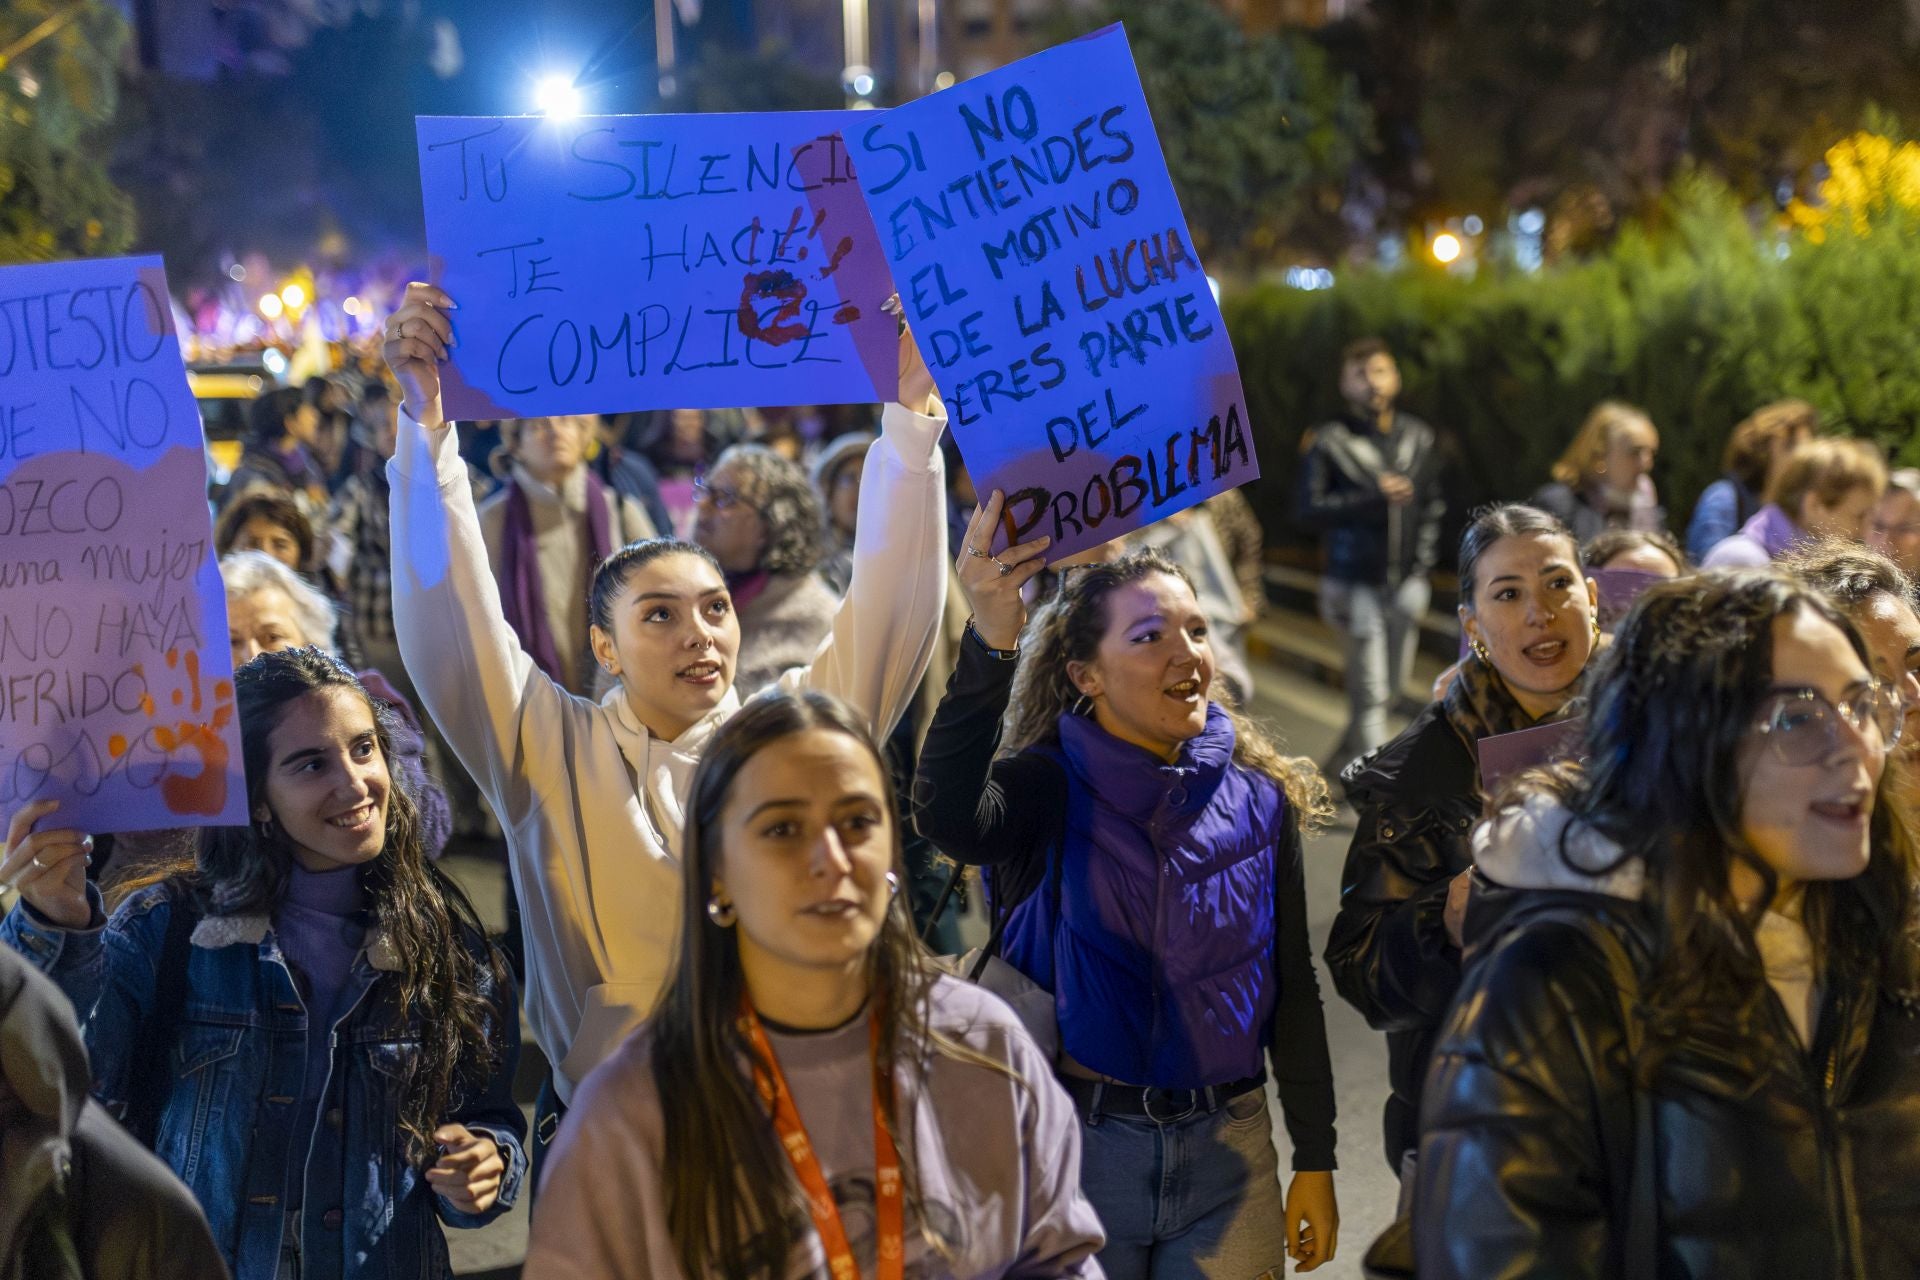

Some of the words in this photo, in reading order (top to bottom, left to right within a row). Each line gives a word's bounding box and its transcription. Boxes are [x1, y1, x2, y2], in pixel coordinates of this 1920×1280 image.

[428, 121, 508, 202] TU
[862, 123, 927, 196] SI
[957, 83, 1041, 162] NO
[887, 103, 1135, 262] ENTIENDES
[476, 237, 563, 299] TE
[640, 222, 808, 283] HACE
[909, 262, 969, 322] EL
[980, 177, 1140, 281] MOTIVO
[929, 310, 993, 369] DE
[1013, 279, 1067, 338] LA
[1074, 226, 1200, 312] LUCHA
[496, 300, 852, 395] COMPLICE
[944, 342, 1068, 427] ERES
[1078, 292, 1214, 378] PARTE
[0, 402, 37, 460] E
[69, 377, 169, 455] NO
[1045, 388, 1150, 463] DEL
[1000, 402, 1250, 548] PROBLEMA
[80, 529, 205, 620] mujer
[1, 603, 73, 664] NO
[95, 596, 202, 658] HAYA
[0, 667, 149, 727] FRIDO
